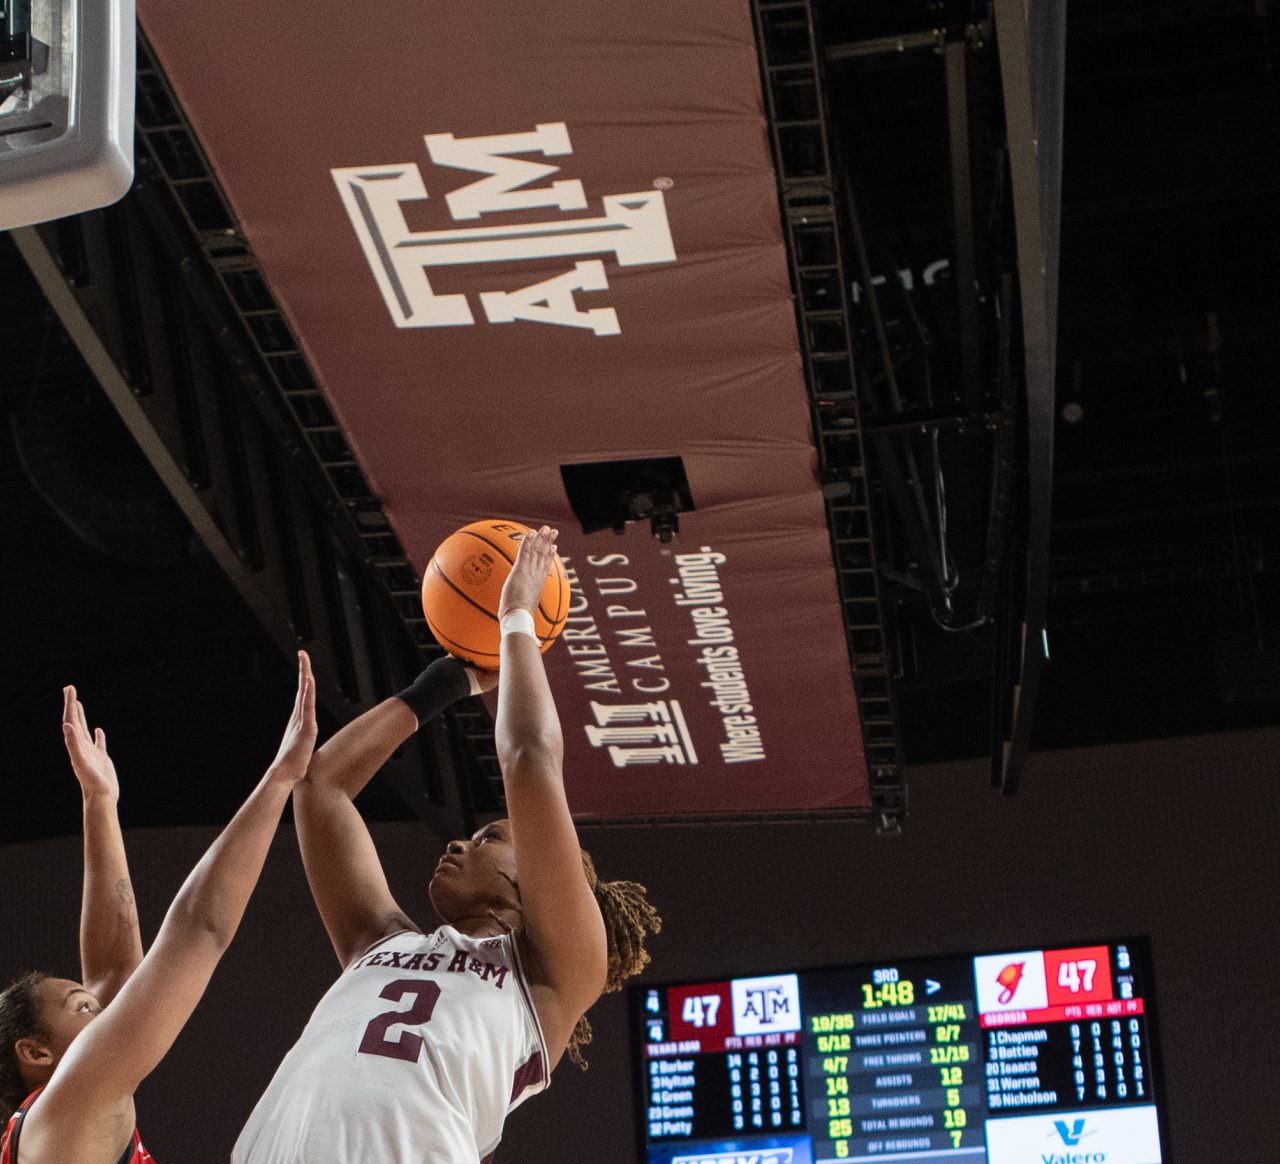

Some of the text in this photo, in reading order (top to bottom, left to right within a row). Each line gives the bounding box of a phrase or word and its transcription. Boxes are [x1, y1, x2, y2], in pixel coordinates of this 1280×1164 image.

[587, 553, 670, 693] CAMPUS
[669, 546, 767, 764] Where students love living.
[447, 949, 509, 990] A&M
[1058, 959, 1097, 993] 47
[861, 980, 914, 1008] 1:48
[358, 979, 441, 1064] 2
[682, 995, 720, 1028] 47
[927, 1004, 966, 1023] 17/41
[984, 1011, 1027, 1026] GEORGIA
[935, 1025, 961, 1043] 2/7
[997, 1029, 1048, 1045] Chapman
[659, 1060, 695, 1073] Barker
[823, 1056, 848, 1074] 4/7
[930, 1045, 970, 1065] 11/15
[826, 1076, 849, 1096] 14
[940, 1066, 963, 1087] 12
[1001, 1077, 1040, 1091] Warren
[828, 1097, 851, 1117] 13
[946, 1088, 960, 1107] 5
[1002, 1091, 1057, 1107] Nicholson
[829, 1118, 853, 1139] 25
[835, 1139, 849, 1158] 5
[950, 1130, 962, 1149] 7
